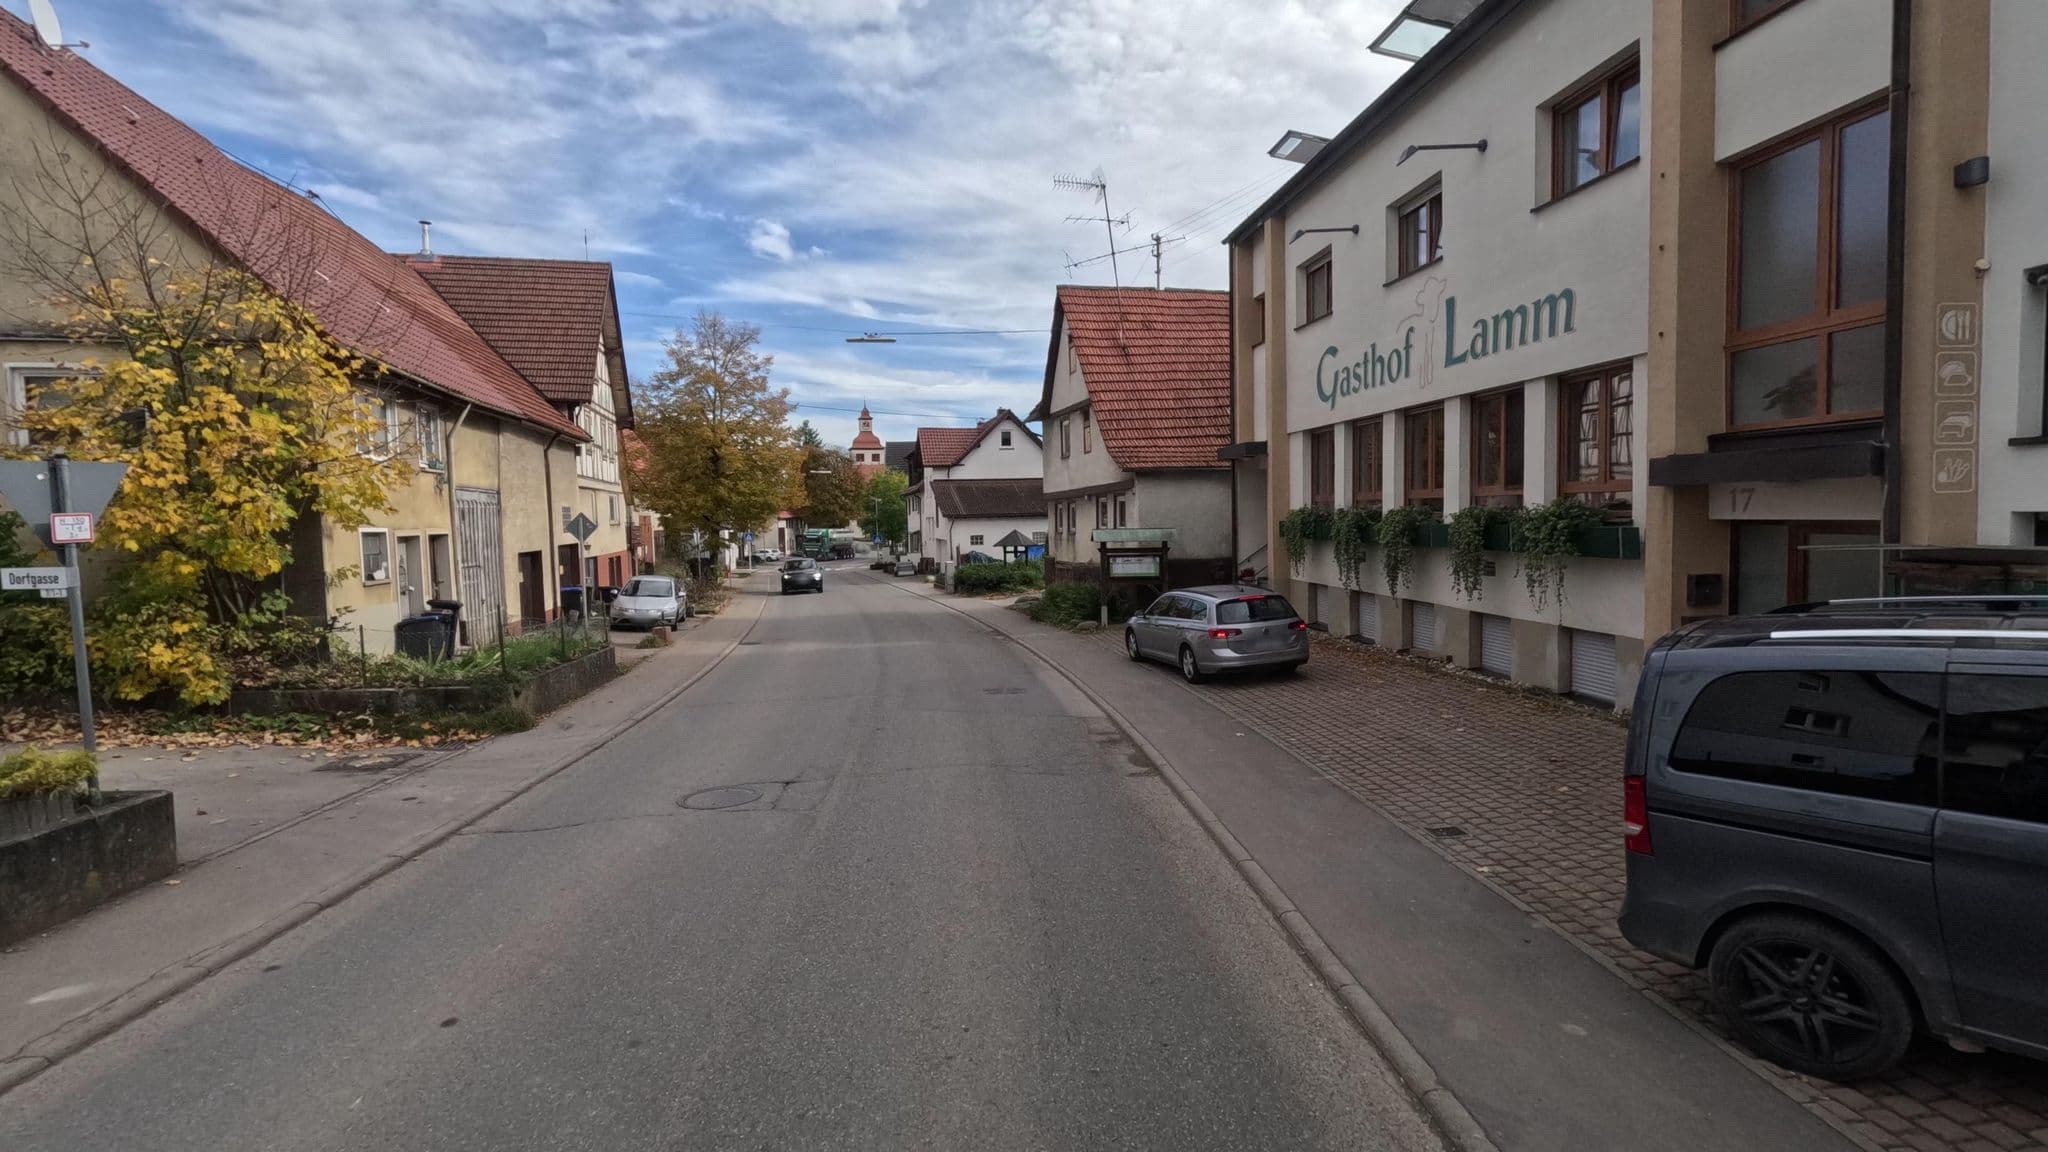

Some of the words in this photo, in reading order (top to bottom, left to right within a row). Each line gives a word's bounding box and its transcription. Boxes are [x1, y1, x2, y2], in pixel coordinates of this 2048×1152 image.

[1316, 326, 1415, 410] Gasthof
[1444, 287, 1577, 368] Lamm
[1729, 487, 1755, 512] 17
[9, 572, 60, 588] Dorfgasse
